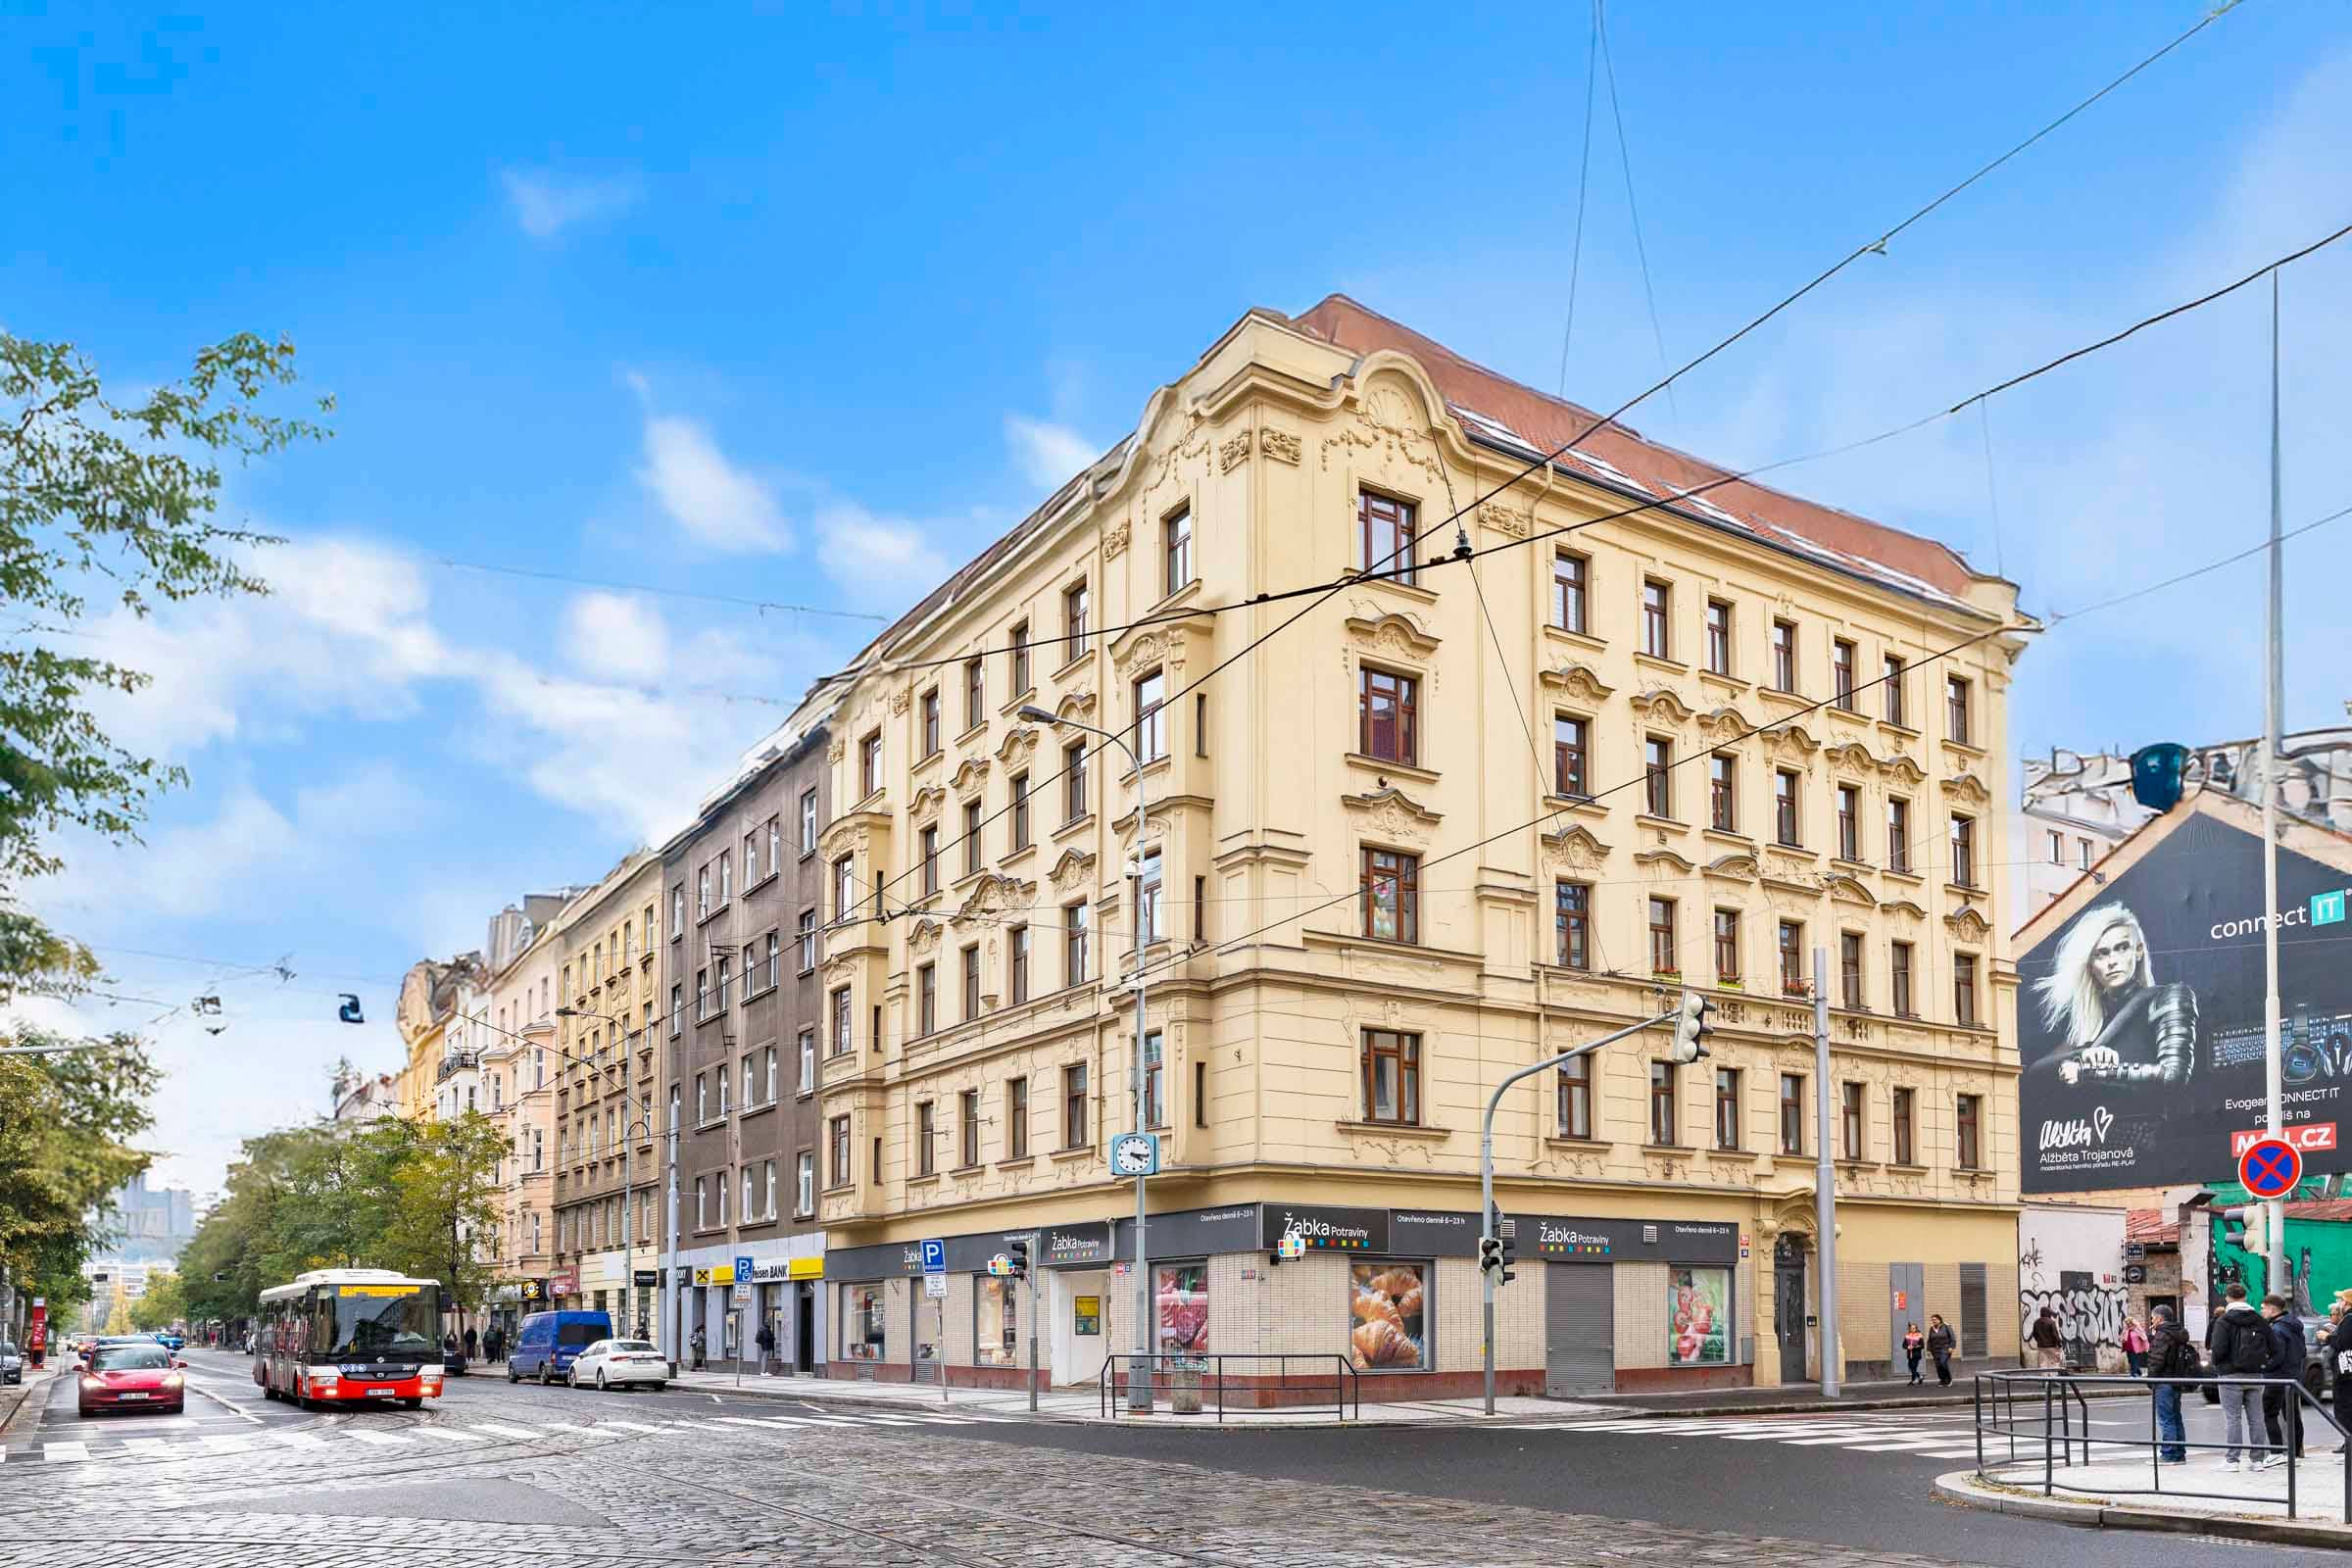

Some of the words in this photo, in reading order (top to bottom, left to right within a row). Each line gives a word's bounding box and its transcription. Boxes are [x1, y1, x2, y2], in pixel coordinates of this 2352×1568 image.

[2210, 906, 2307, 940] connect
[2317, 897, 2339, 920] IT
[2281, 1089, 2327, 1103] ONNECT
[2329, 1087, 2340, 1099] IT
[2296, 1109, 2311, 1120] na
[2039, 1152, 2079, 1163] Alžběta
[2081, 1147, 2133, 1162] Trojanová
[1285, 1211, 1330, 1237] Žabka
[1331, 1226, 1368, 1239] Potraviny
[1396, 1214, 1425, 1224] Otevřeno
[1425, 1216, 1445, 1225] denně
[1052, 1231, 1077, 1251] Žabka
[1540, 1221, 1578, 1244] Žabka
[1578, 1234, 1610, 1247] Potraviny
[925, 1244, 940, 1263] P
[739, 1260, 750, 1277] P
[769, 1264, 788, 1279] BANK
